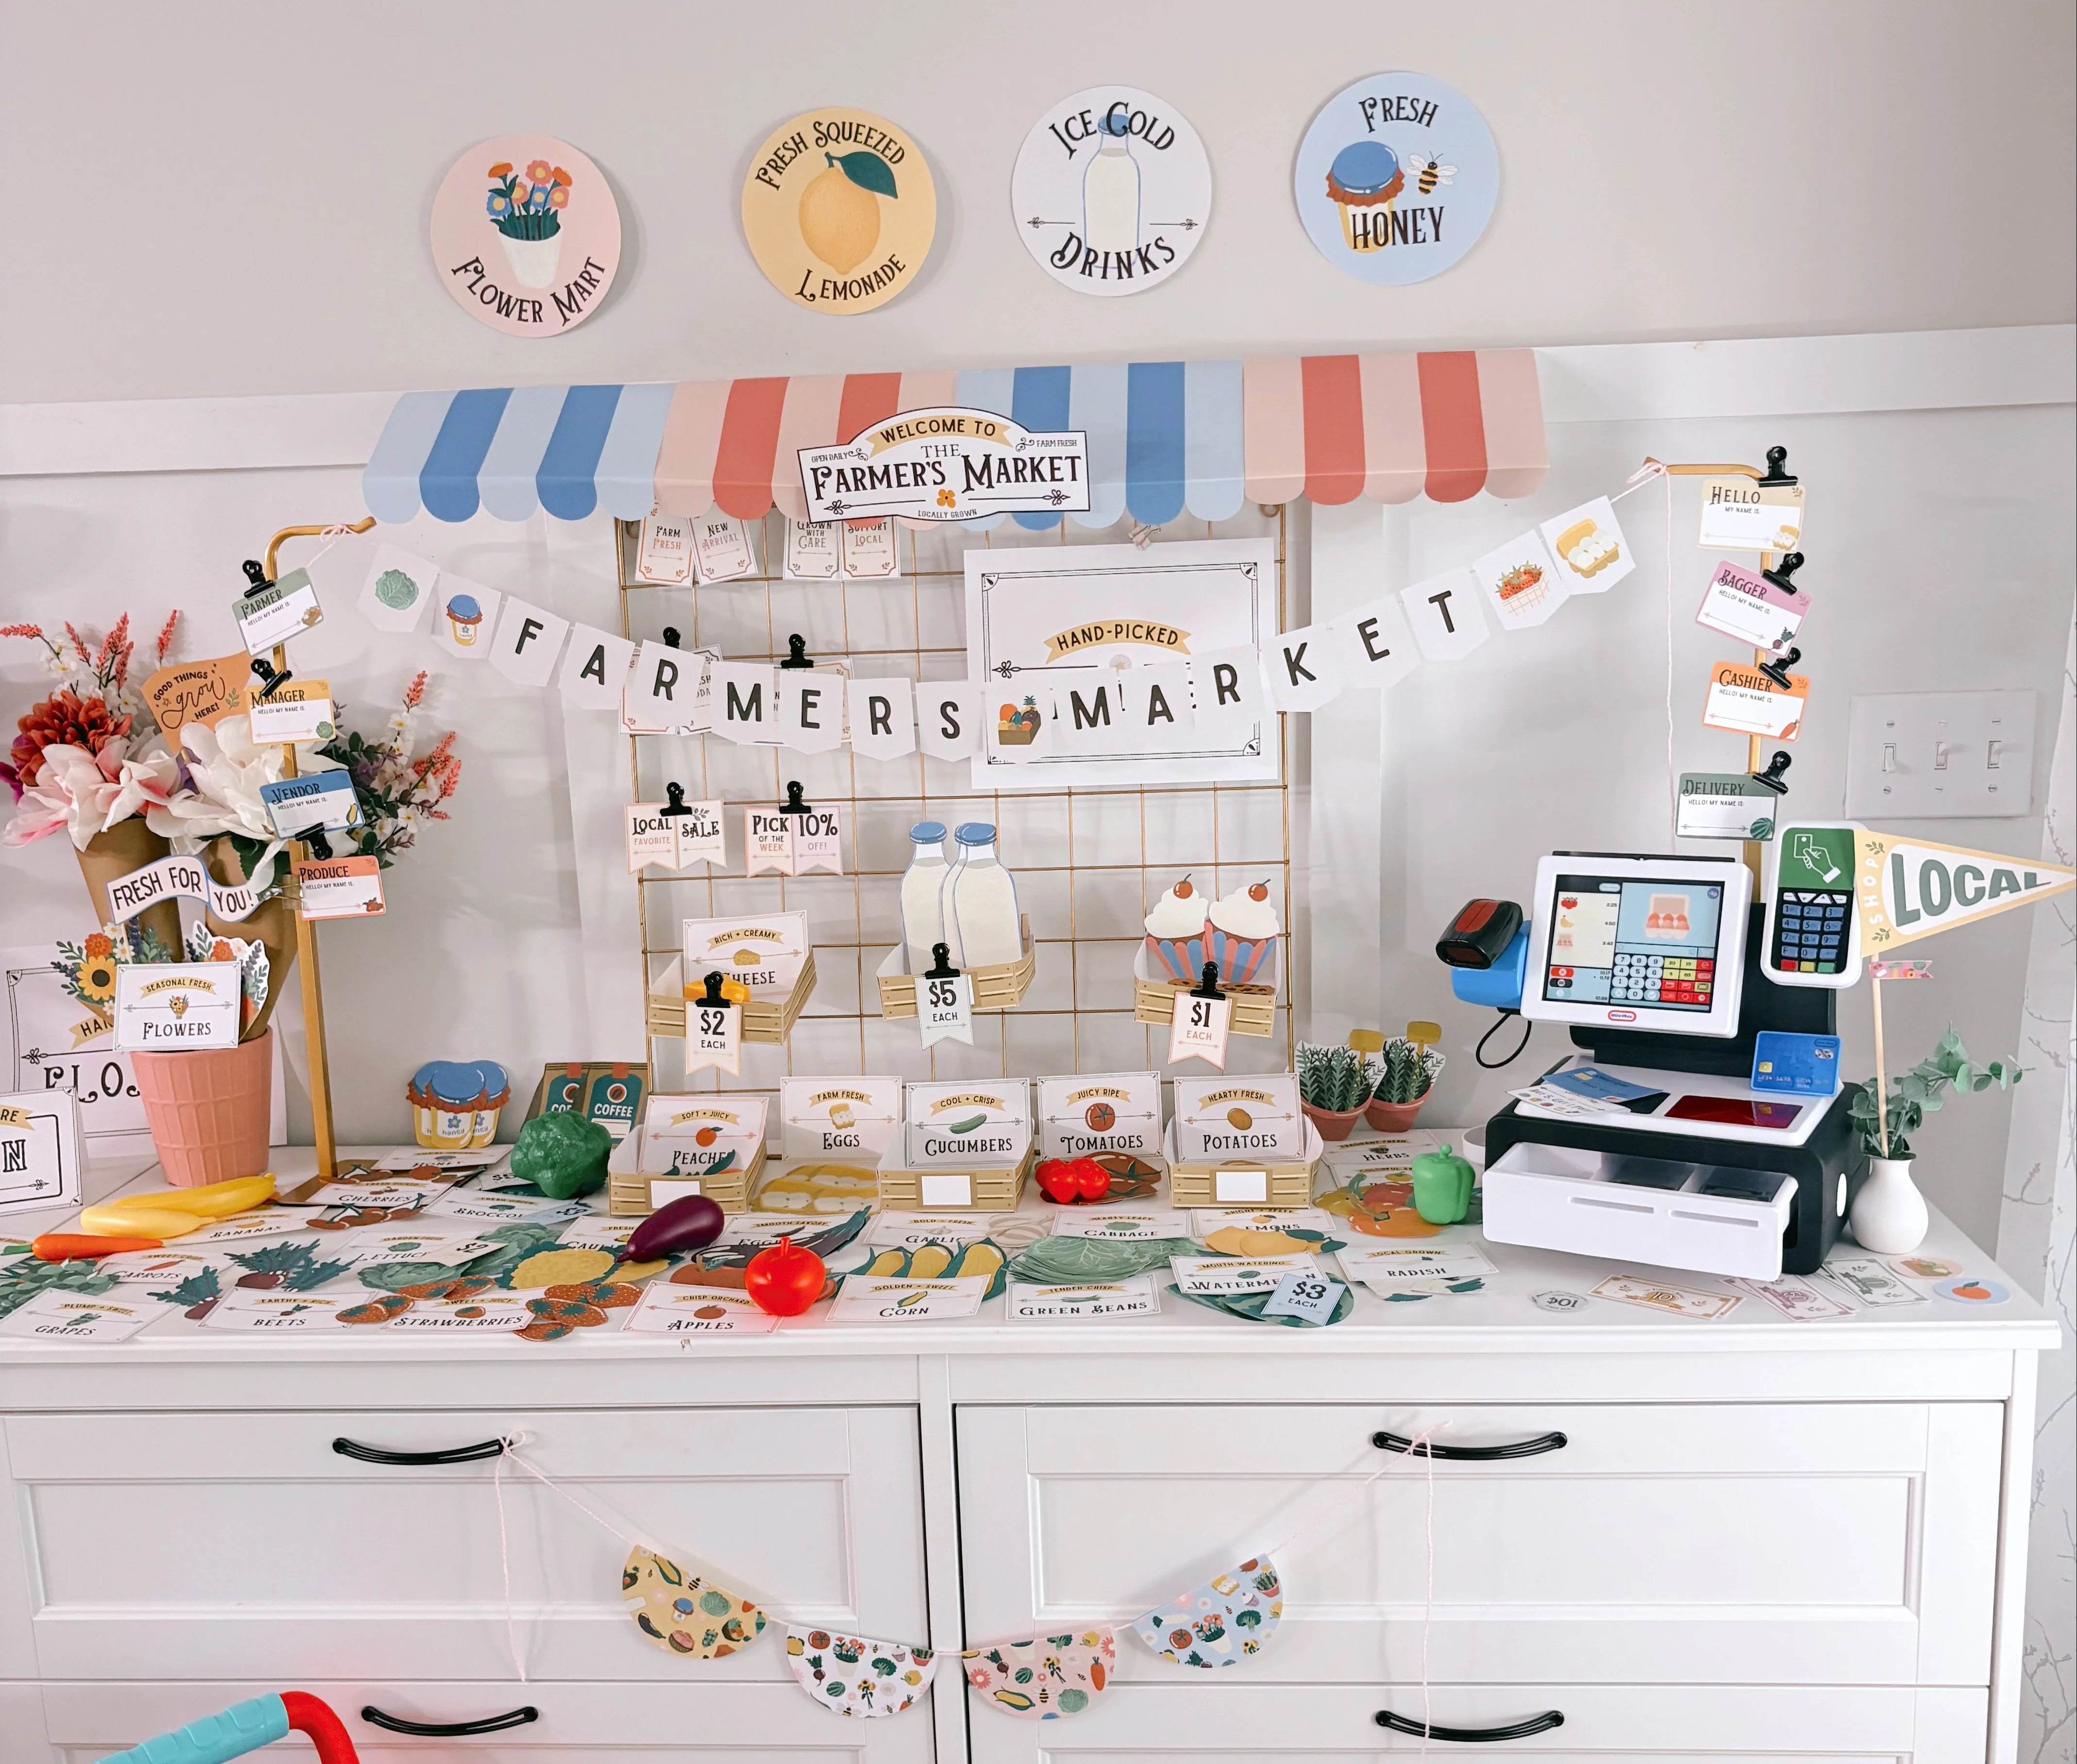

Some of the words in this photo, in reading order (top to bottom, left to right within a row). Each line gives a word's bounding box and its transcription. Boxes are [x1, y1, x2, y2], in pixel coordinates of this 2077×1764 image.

[1358, 97, 1438, 133] FRESH
[1049, 110, 1097, 159] ICE
[1106, 101, 1175, 151] COLD
[755, 131, 808, 190] FRESH
[813, 120, 905, 165] SQUEEZED
[1351, 206, 1444, 250] HONEY
[1050, 231, 1175, 279] DRINKS
[795, 253, 906, 302] LEMONADE
[452, 256, 543, 323] FLOWER
[550, 256, 606, 326] MART
[880, 419, 965, 444] WELCOME
[974, 421, 996, 436] TO
[921, 444, 961, 458] THE
[961, 454, 1082, 493] MARKET
[1708, 487, 1761, 505] HELLO
[918, 510, 948, 519] LOCALLY
[950, 509, 977, 518] GROWN
[656, 526, 680, 538] FARM
[707, 522, 728, 538] NEW
[653, 538, 681, 550] FRESH
[702, 533, 739, 552] ARRIVAL
[799, 536, 826, 549] CARE
[855, 535, 883, 548] LOCAL
[1718, 569, 1767, 600] BAGGER
[241, 589, 283, 620] FARMER
[271, 605, 285, 615] NAME
[1738, 597, 1747, 605] MY
[1748, 601, 1763, 612] NAME
[1056, 623, 1178, 651] HAND-PICKED
[515, 618, 960, 739] FARMERS
[1071, 590, 1455, 730] MARKET
[153, 682, 173, 701] GOOD
[173, 671, 208, 684] THINGS
[1719, 670, 1773, 692] CASHIER
[161, 676, 225, 729] grow
[195, 703, 219, 721] HERE!
[272, 783, 321, 805] VENDOR
[1682, 779, 1745, 797] DELIVERY
[632, 817, 672, 835] LOCAL
[682, 821, 720, 839] SALE
[753, 815, 789, 835] PICK
[799, 814, 838, 837] 10%
[634, 837, 670, 845] FAVORITE
[760, 842, 784, 851] WEEK
[808, 842, 827, 850] OFF!
[300, 866, 350, 883] PRODUCE
[113, 873, 162, 910] FRESH
[171, 866, 201, 893] FOR
[1863, 857, 1884, 925] SHOP
[1892, 853, 2052, 928] LOCAL
[214, 889, 254, 913] YOU!
[715, 932, 733, 944] RICH
[744, 930, 776, 940] CREAMY
[146, 978, 186, 992] SEASONAL
[189, 977, 212, 991] FRESH
[728, 971, 776, 985] HEESE
[929, 980, 956, 1008] $5
[701, 1009, 725, 1036] $2
[933, 1012, 958, 1022] EACH
[1191, 1001, 1210, 1028] $1
[143, 1022, 211, 1040] FLOWERS
[1187, 1030, 1212, 1042] EACH
[701, 1040, 725, 1049] EACH
[818, 1090, 839, 1101] FARM
[841, 1091, 864, 1102] FRESH
[940, 1097, 963, 1108] COOL
[973, 1095, 995, 1105] CRISP
[1077, 1089, 1099, 1099] JUICY
[1104, 1089, 1120, 1098] RIPE
[1208, 1090, 1238, 1103] HEARTY
[1241, 1090, 1265, 1101] FRESH
[595, 1103, 633, 1117] COFFEE
[682, 1111, 700, 1119] SOFT
[709, 1111, 730, 1120] JUICY
[823, 1132, 860, 1150] EGGS
[925, 1138, 1013, 1157] CUCUMBERS
[1060, 1135, 1143, 1154] TOMATOES
[1203, 1134, 1277, 1152] POTATOES
[673, 1151, 730, 1166] PEACHE
[1363, 1153, 1409, 1161] HERBS
[454, 1208, 522, 1218] BROCCOL
[456, 1243, 489, 1253] $2
[1387, 1268, 1447, 1277] RADISH
[1188, 1273, 1316, 1290] WATERMEN
[1291, 1280, 1326, 1300] $3
[711, 1296, 750, 1305] ORCHARD
[1288, 1298, 1318, 1309] EACH
[1652, 1291, 1674, 1302] 10
[879, 1307, 929, 1317] CORN
[1020, 1307, 1080, 1315] GREEN
[1091, 1302, 1147, 1314] BEANS
[394, 1316, 523, 1327] STRAWBERRIES
[667, 1320, 735, 1331] APPLES
[35, 1325, 96, 1336] GRAPES
